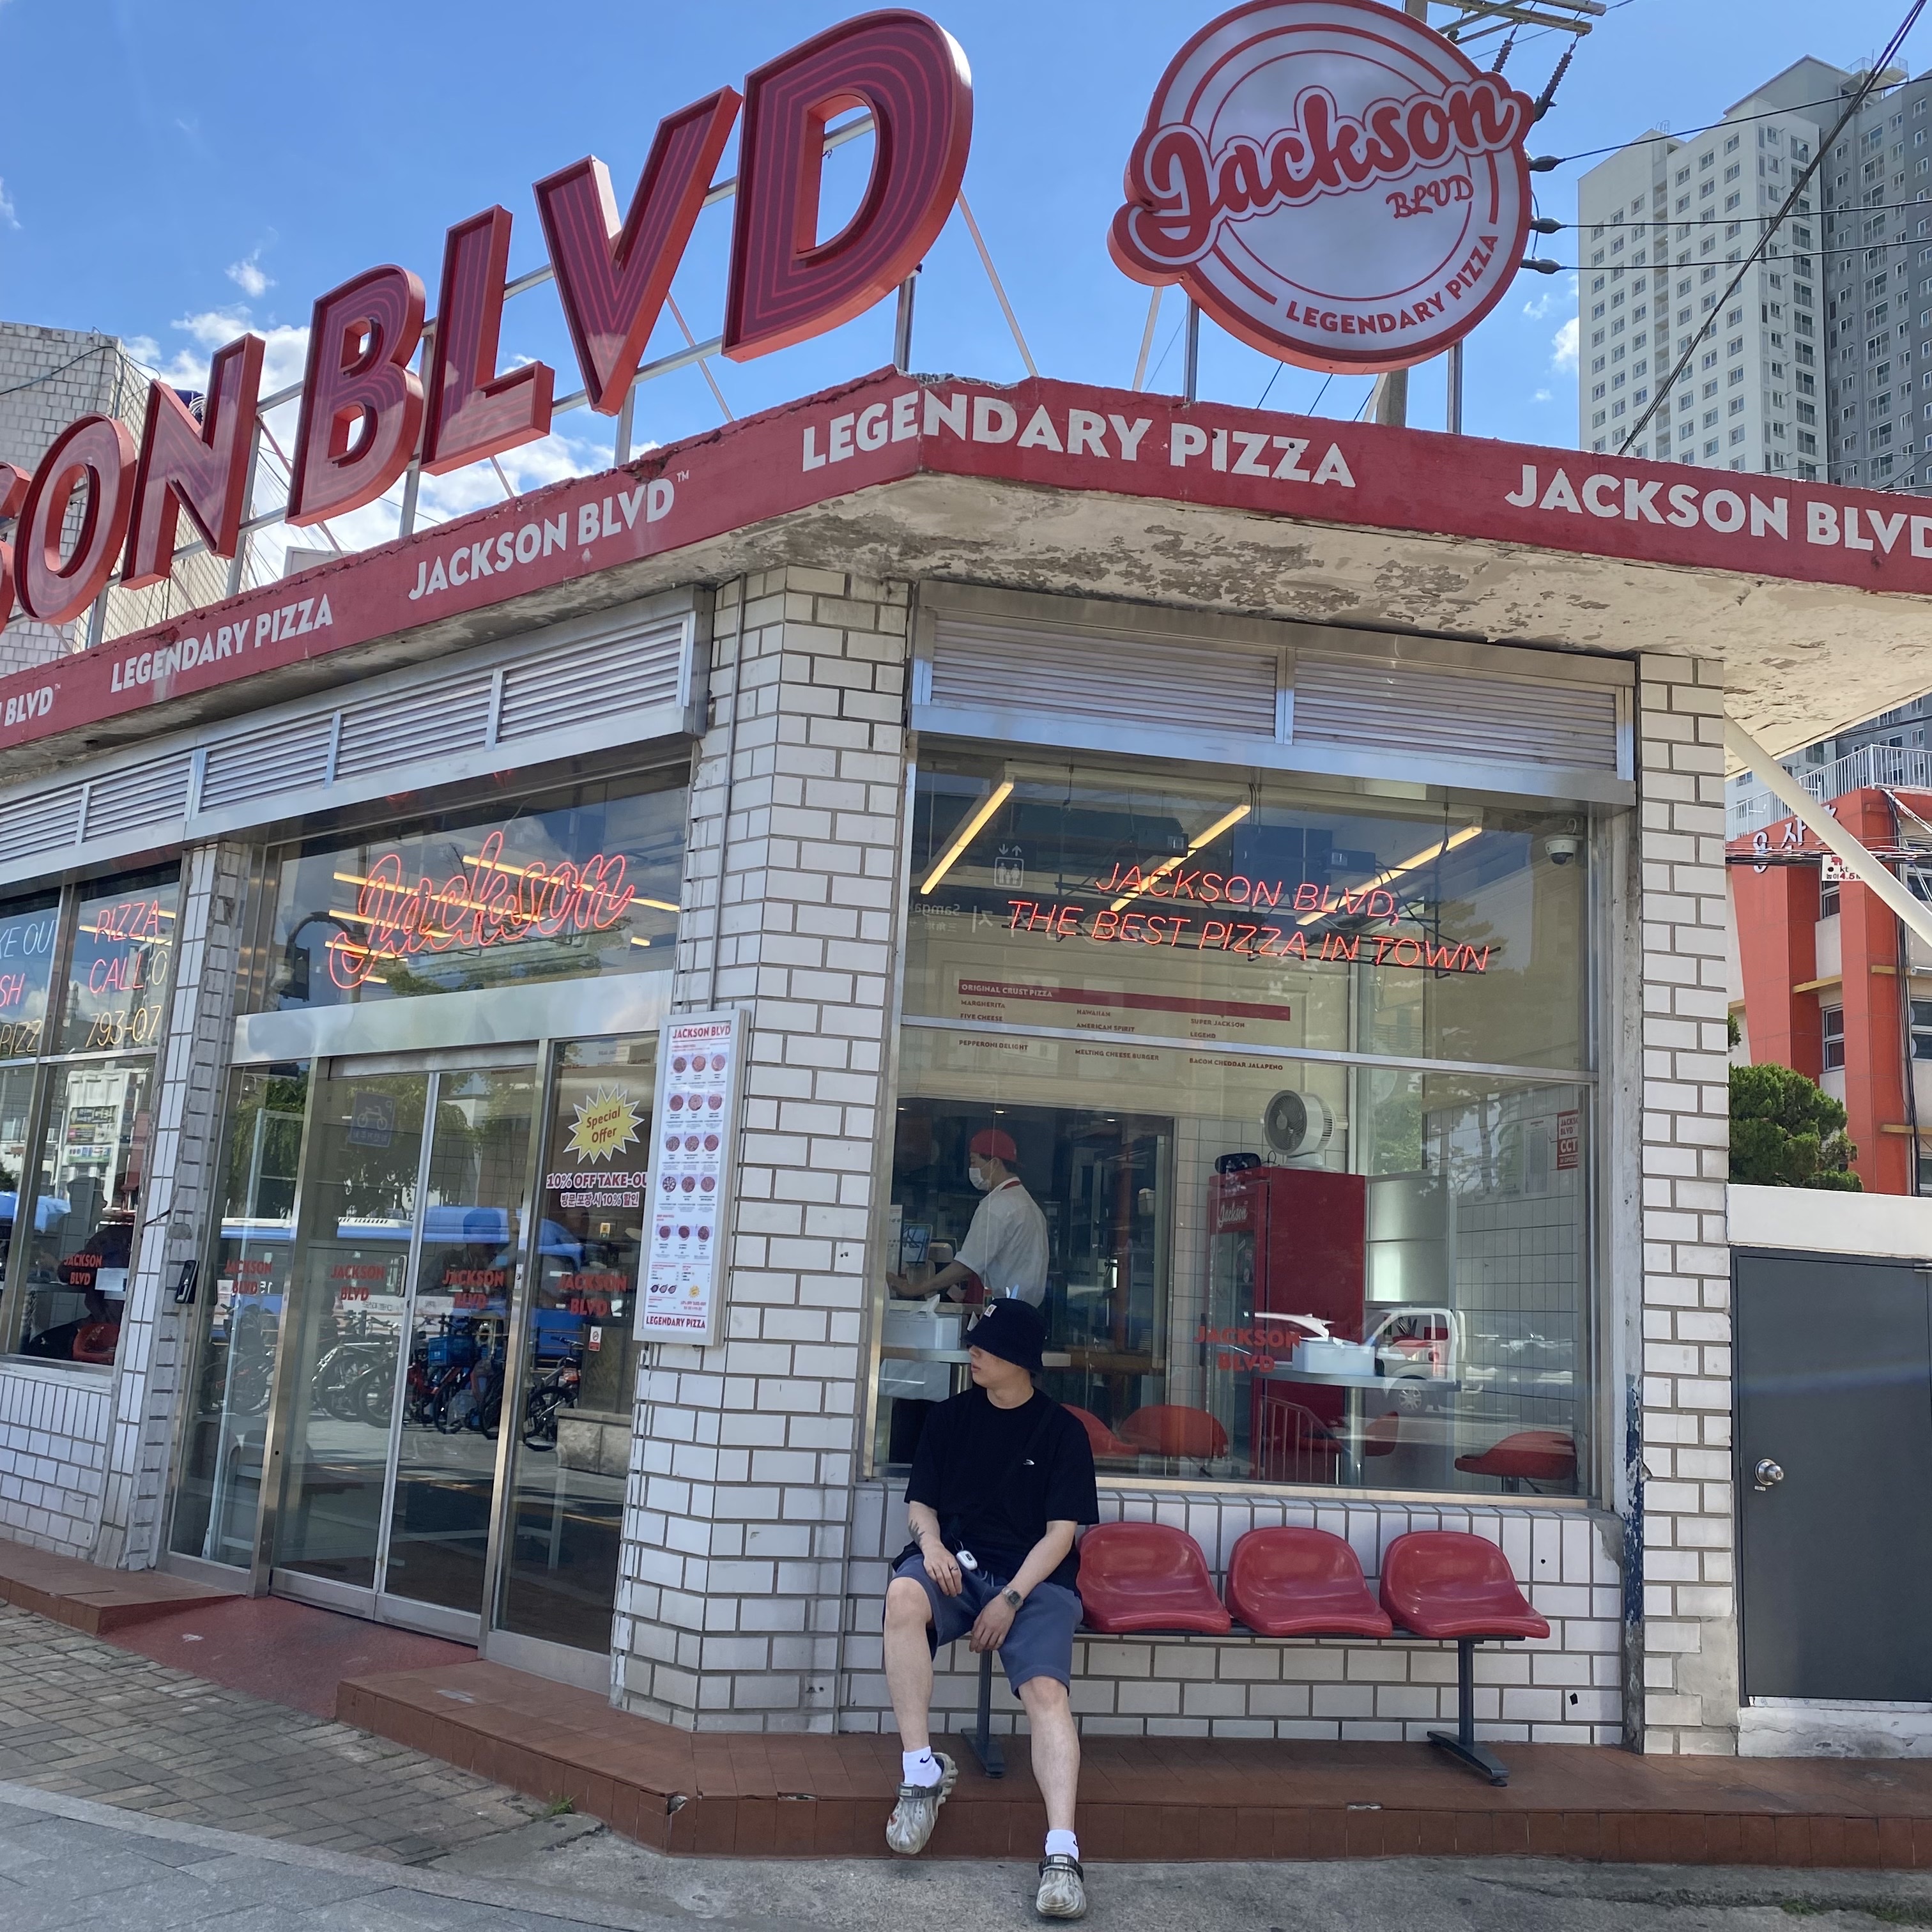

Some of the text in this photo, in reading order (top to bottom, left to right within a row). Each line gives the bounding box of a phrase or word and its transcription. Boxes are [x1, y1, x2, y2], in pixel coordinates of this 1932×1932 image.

[1135, 85, 1515, 253] Jackson
[1386, 175, 1473, 219] BLVD
[286, 8, 973, 526] BLVD
[1286, 235, 1498, 335] LEGENDARY PIZZA
[802, 390, 1356, 487] LEGENDARY PIZZA
[1505, 464, 1788, 540] JACKSON
[408, 512, 567, 600] JACKSON
[578, 479, 675, 546] BLVD
[111, 594, 333, 693] LEGENDARY PIZZA
[4, 686, 53, 726] BLVD
[1095, 862, 1399, 926] JACKSON BLVD,
[95, 900, 159, 944] PIZZA
[330, 831, 635, 989] Jackson
[23, 919, 57, 956] OU
[1008, 901, 1489, 971] THE BEST PIZZA IN TOWN
[89, 953, 144, 993] CALL
[962, 985, 1000, 993] ORIGINAL
[1002, 987, 1029, 995] CRUST
[961, 1000, 1006, 1008] MARGHERITA
[85, 1005, 162, 1048] 793-07
[672, 1024, 731, 1039] JACKSON BLVD
[959, 1039, 1029, 1050] PEPPERONI DELIGHT
[586, 1106, 620, 1130] Special
[592, 1127, 617, 1144] Offer
[547, 1174, 572, 1188] 10%
[574, 1174, 596, 1188] OFF
[561, 1193, 576, 1207] 방문
[602, 1193, 622, 1206] 10%
[623, 1192, 639, 1207] 할인
[64, 1254, 103, 1268] JACKSON
[331, 1264, 386, 1280] JACKSON
[70, 1272, 91, 1285] BLVD
[442, 1269, 505, 1287] JACKSON
[341, 1286, 369, 1301] BLVD
[570, 1298, 608, 1317] BLVD
[646, 1315, 706, 1329] LEGENDARY PIZZA
[1194, 1326, 1301, 1349] JACKSON
[1218, 1353, 1275, 1372] BLVD
